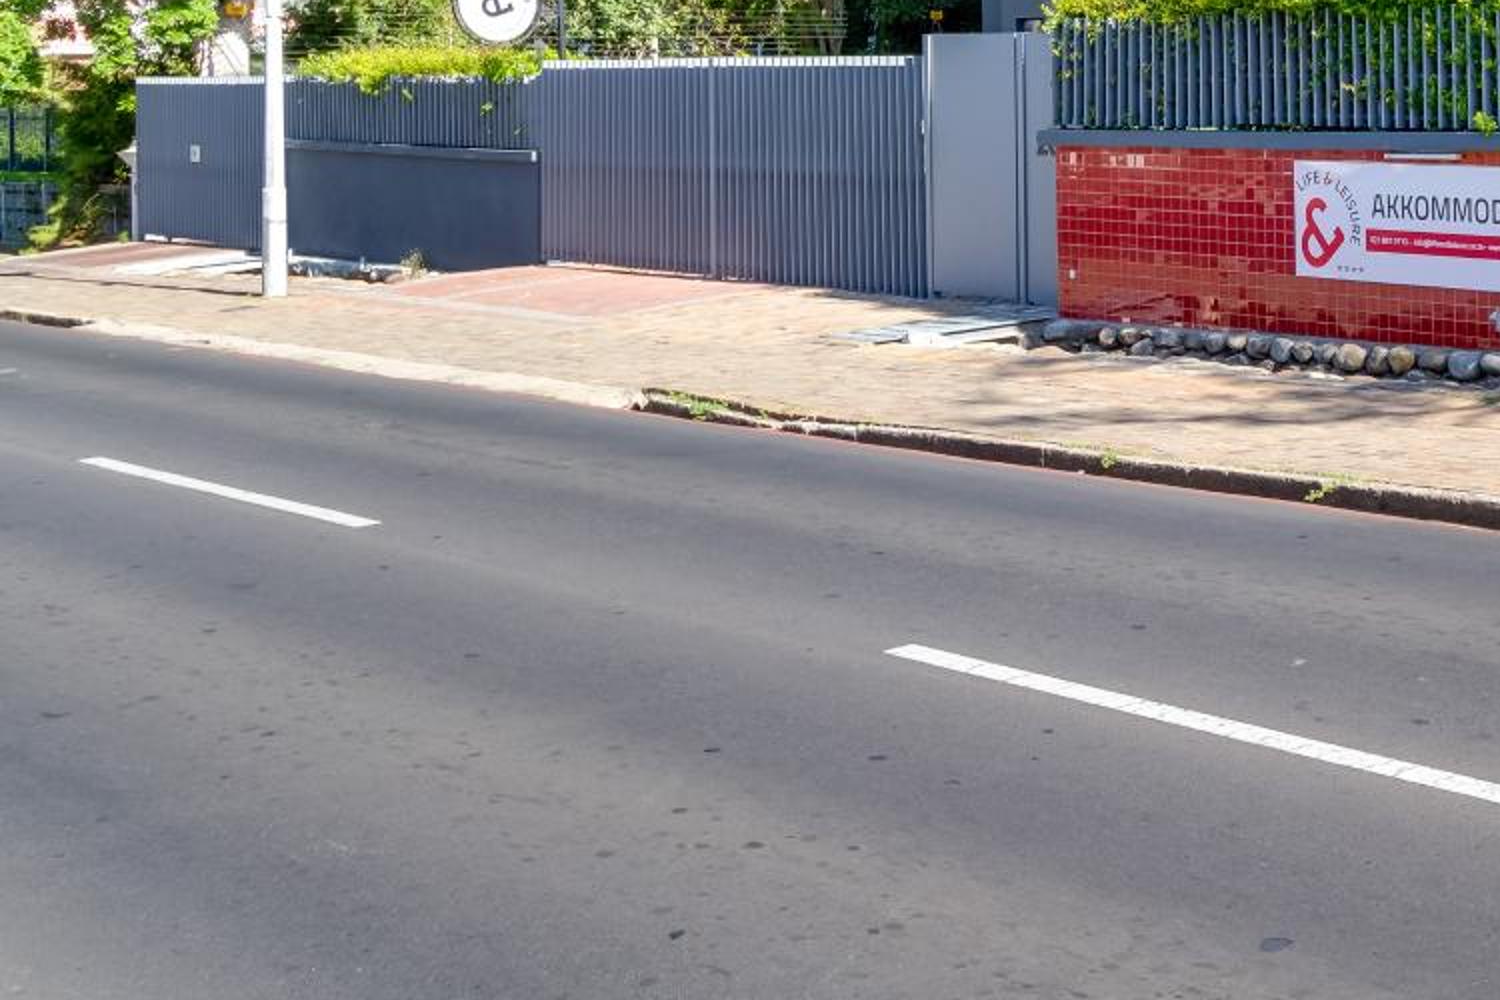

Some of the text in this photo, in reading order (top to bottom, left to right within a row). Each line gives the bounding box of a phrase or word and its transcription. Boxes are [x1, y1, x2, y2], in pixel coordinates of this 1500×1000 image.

[1296, 169, 1321, 191] LIFE
[1335, 179, 1361, 247] LEISURE
[1302, 197, 1345, 268] &
